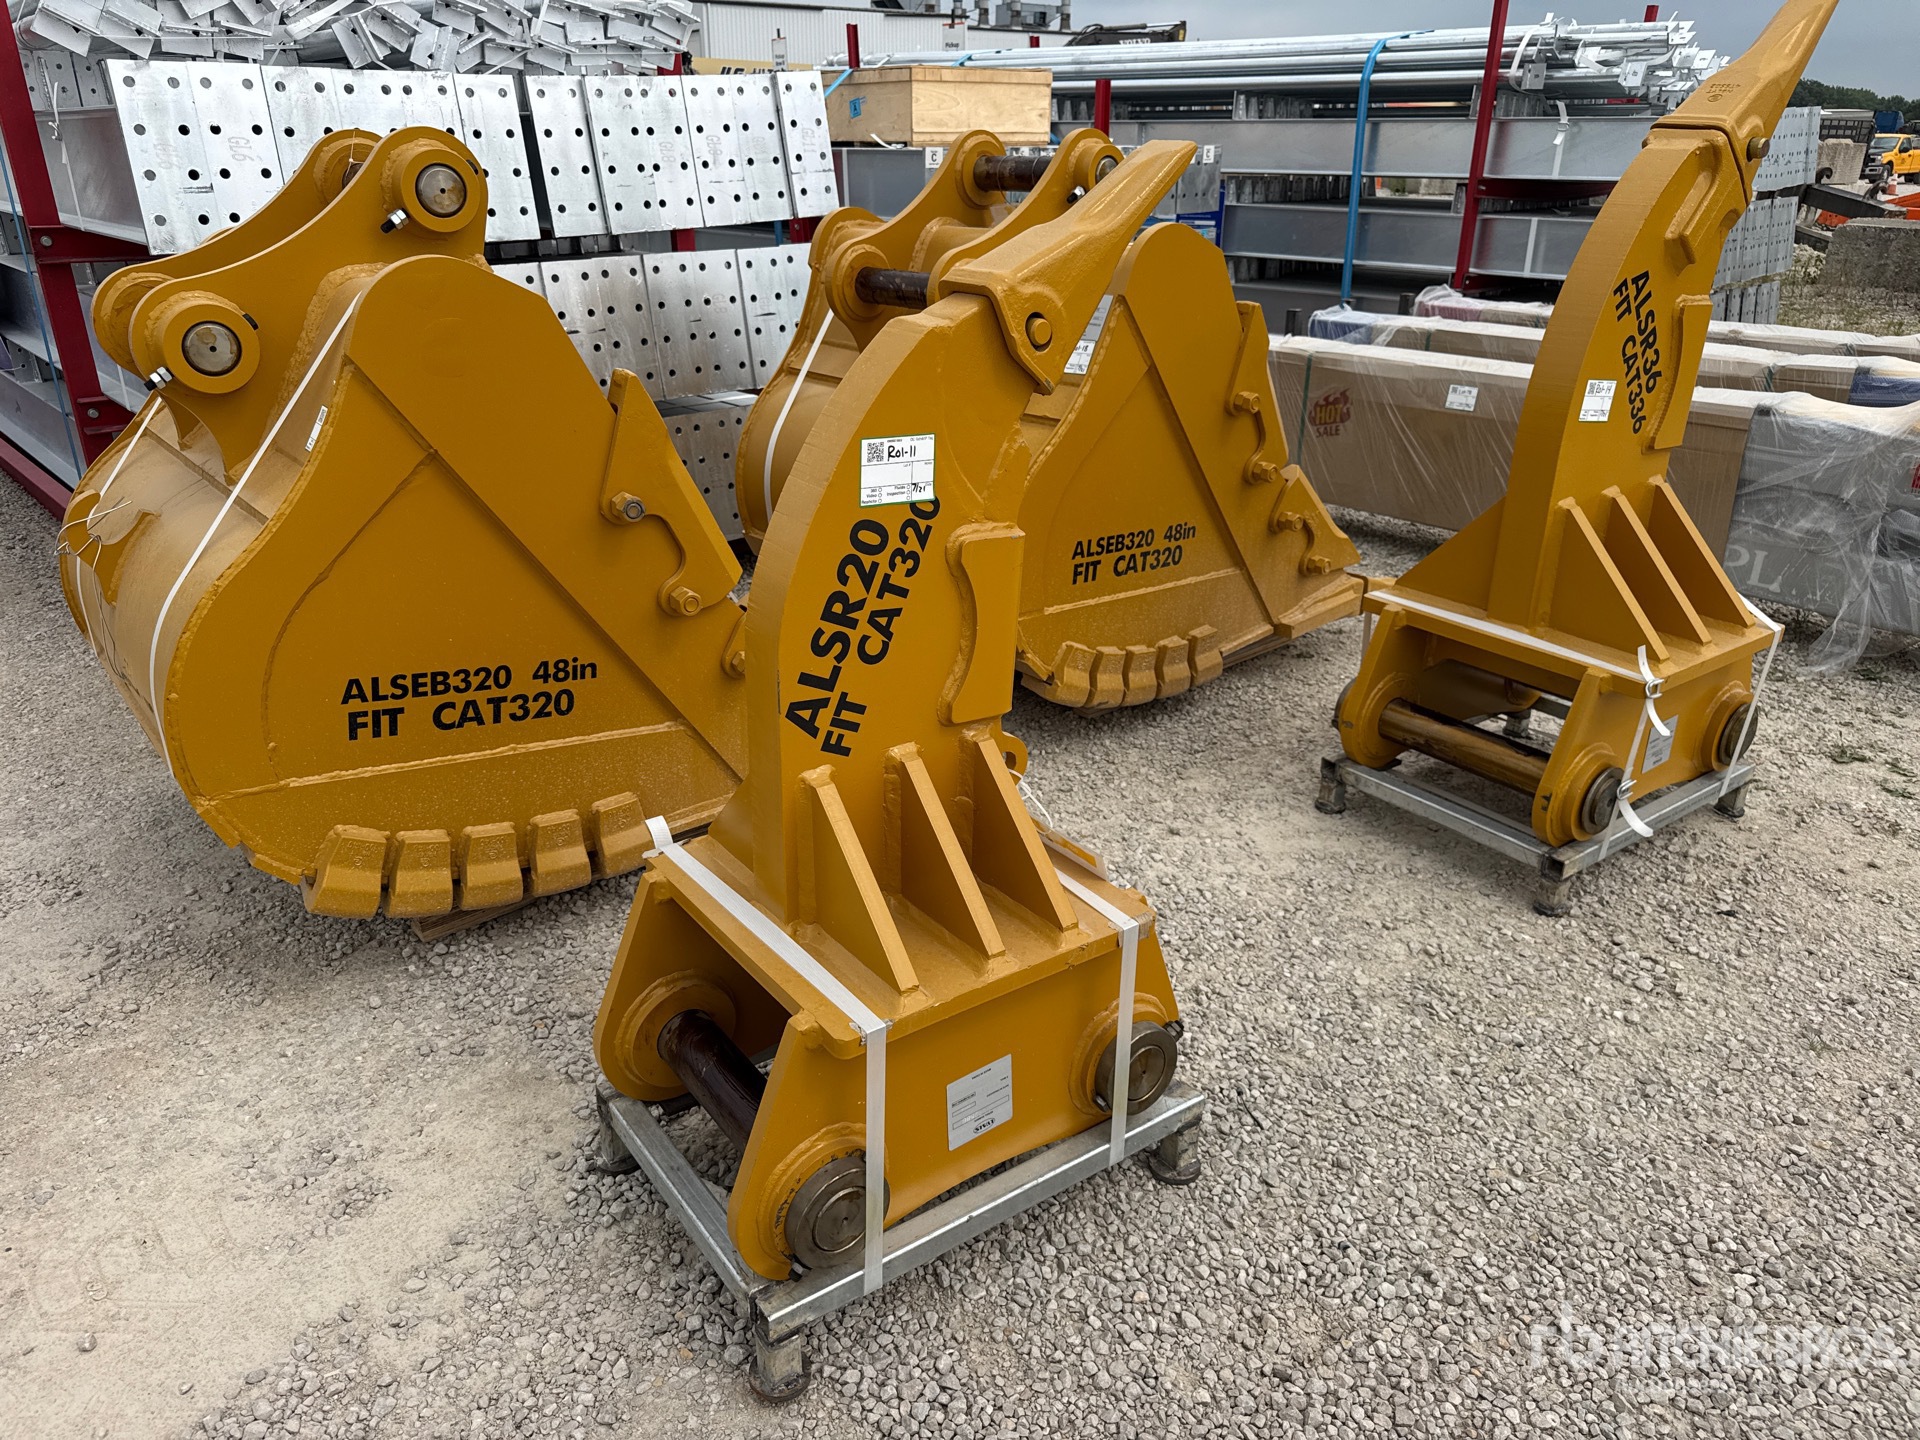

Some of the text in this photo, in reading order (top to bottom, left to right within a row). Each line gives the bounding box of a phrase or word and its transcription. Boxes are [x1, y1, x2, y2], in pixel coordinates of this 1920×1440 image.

[1119, 37, 1151, 46] VOLVO
[1613, 277, 1647, 435] FIT CAT336
[1631, 270, 1663, 394] ALSR36
[1315, 404, 1343, 425] HOT
[1316, 425, 1341, 438] SALE
[1072, 522, 1196, 560] ALSEB320 48in
[1072, 545, 1183, 585] FIT CAT320
[785, 519, 889, 739] ALSR20
[820, 497, 941, 757] FIT CAT320
[341, 656, 598, 705] ALSEB320 48in
[348, 688, 575, 741] FIT CAT320
